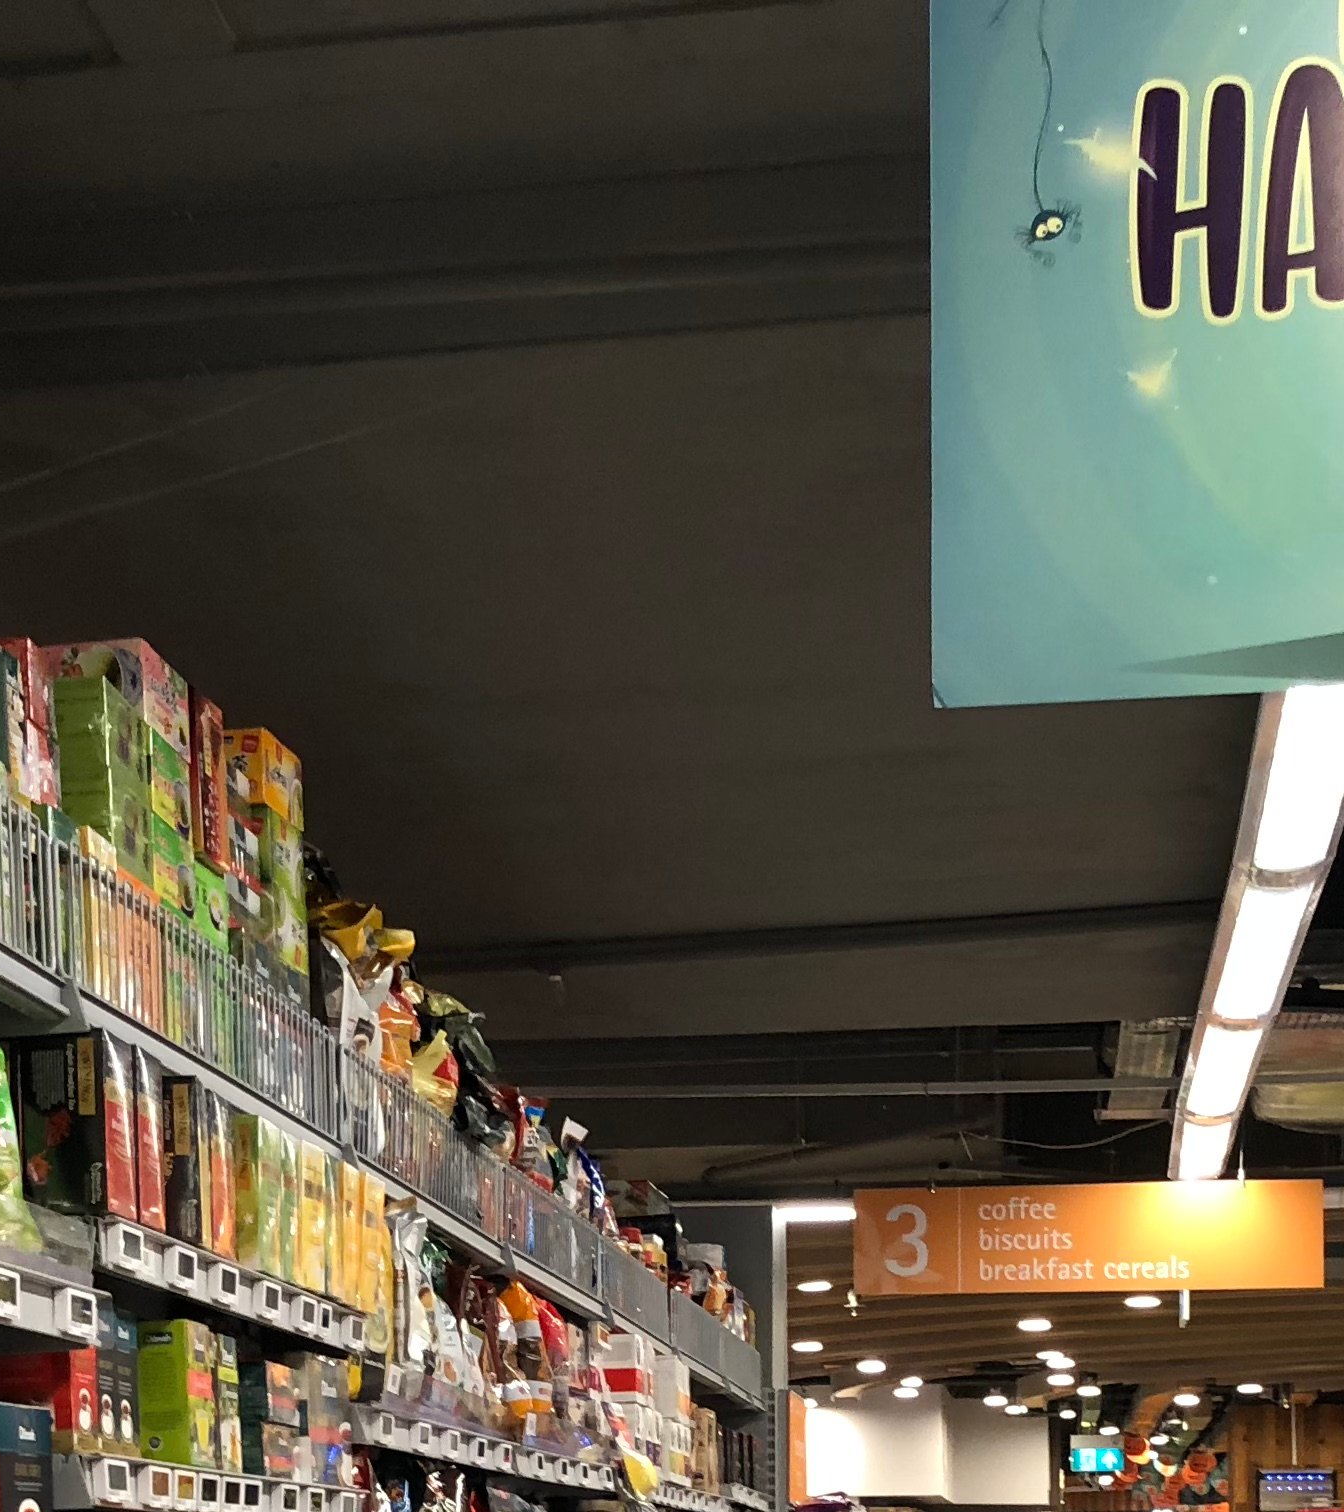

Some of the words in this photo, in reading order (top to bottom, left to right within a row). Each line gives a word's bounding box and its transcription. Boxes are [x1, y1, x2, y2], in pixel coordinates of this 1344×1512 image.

[978, 1196, 1057, 1221] coffee
[883, 1203, 929, 1278] 3
[978, 1226, 1073, 1251] biscuits
[978, 1257, 1094, 1281] breakfast
[1103, 1255, 1191, 1280] cereals
